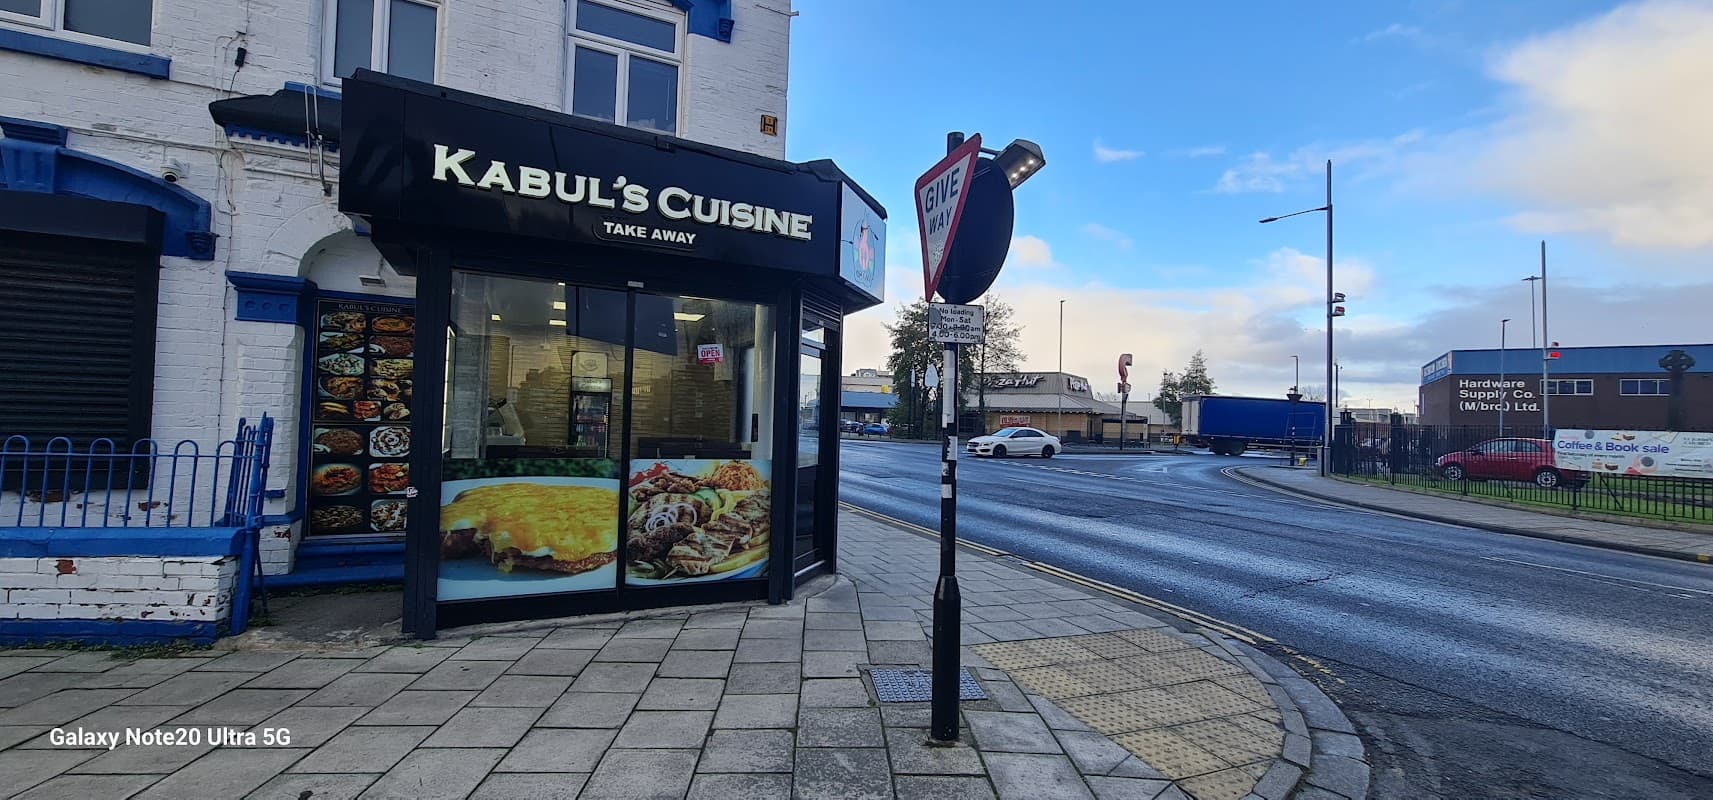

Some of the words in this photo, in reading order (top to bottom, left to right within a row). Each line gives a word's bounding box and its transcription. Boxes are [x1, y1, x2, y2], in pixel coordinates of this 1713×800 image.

[925, 167, 960, 213] GIVE
[657, 187, 813, 241] CUISINE
[929, 206, 952, 235] WAY
[603, 221, 647, 239] TAKE
[651, 228, 697, 245] AWAY
[939, 307, 949, 315] No
[950, 308, 974, 317] loading
[701, 350, 720, 358] OPEN
[1459, 379, 1526, 389] Hardware
[1459, 389, 1508, 400] Supply
[1512, 389, 1536, 399] Co.
[1514, 402, 1541, 412] Ltd.
[1557, 440, 1593, 450] Coffee
[1594, 441, 1604, 451] &
[1605, 442, 1639, 453] Book
[1642, 444, 1670, 454] sale
